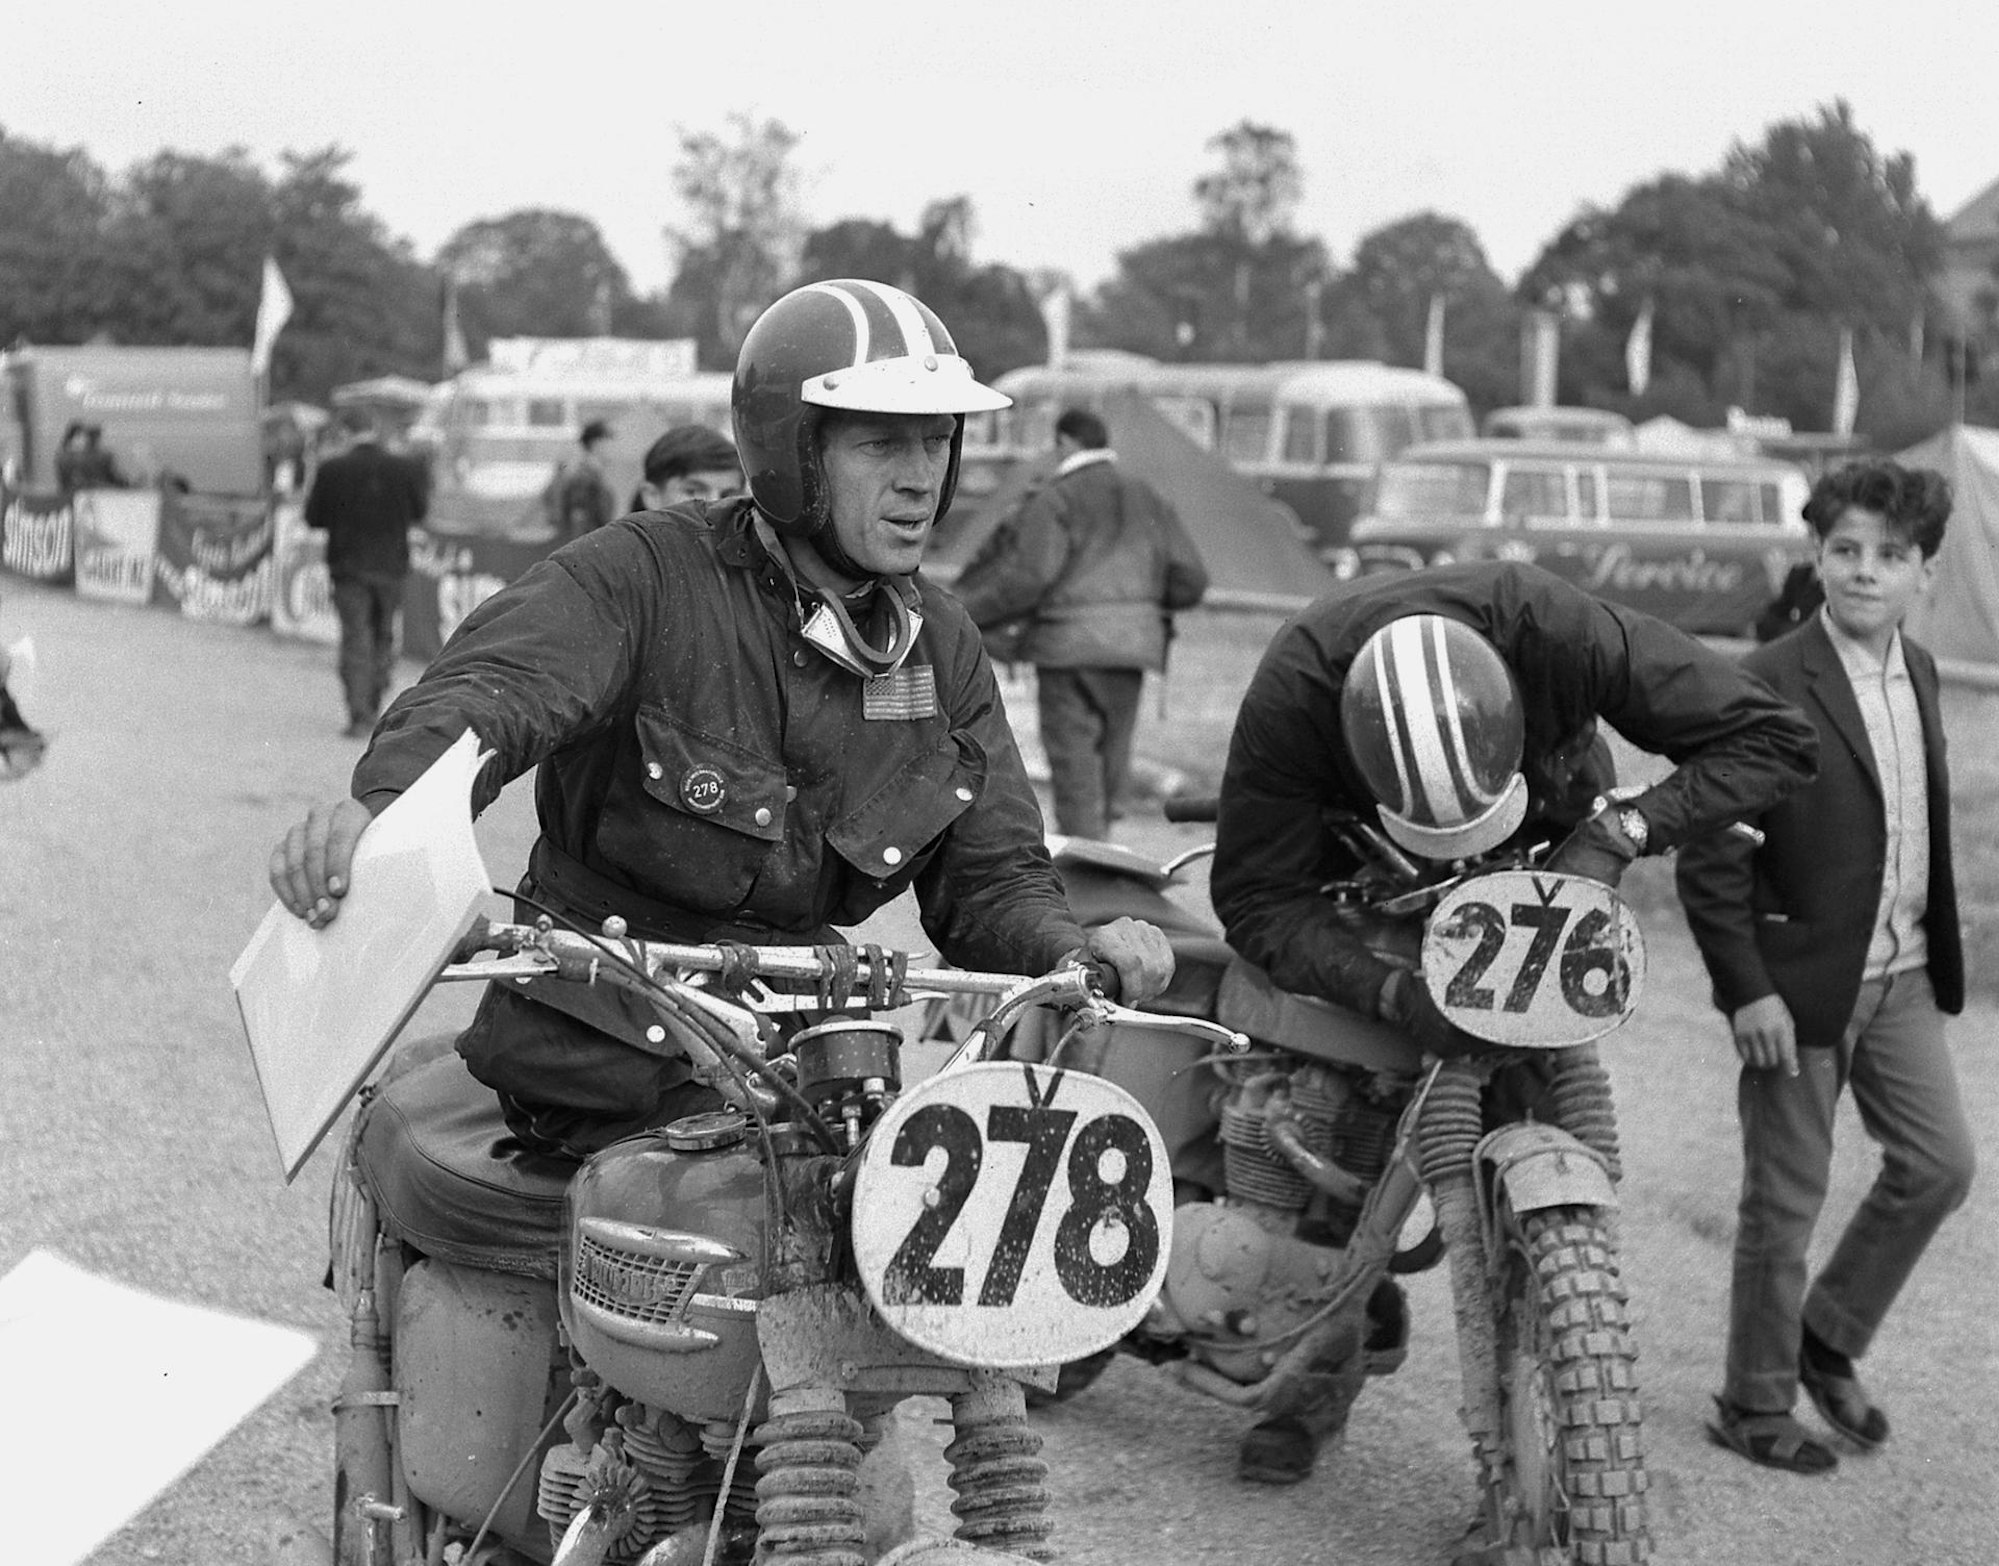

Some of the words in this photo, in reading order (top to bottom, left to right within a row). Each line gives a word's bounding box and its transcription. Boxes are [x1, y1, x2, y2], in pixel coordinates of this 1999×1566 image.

[692, 781, 719, 799] 278
[1441, 902, 1631, 1018] 276
[882, 1104, 1160, 1307] 278
